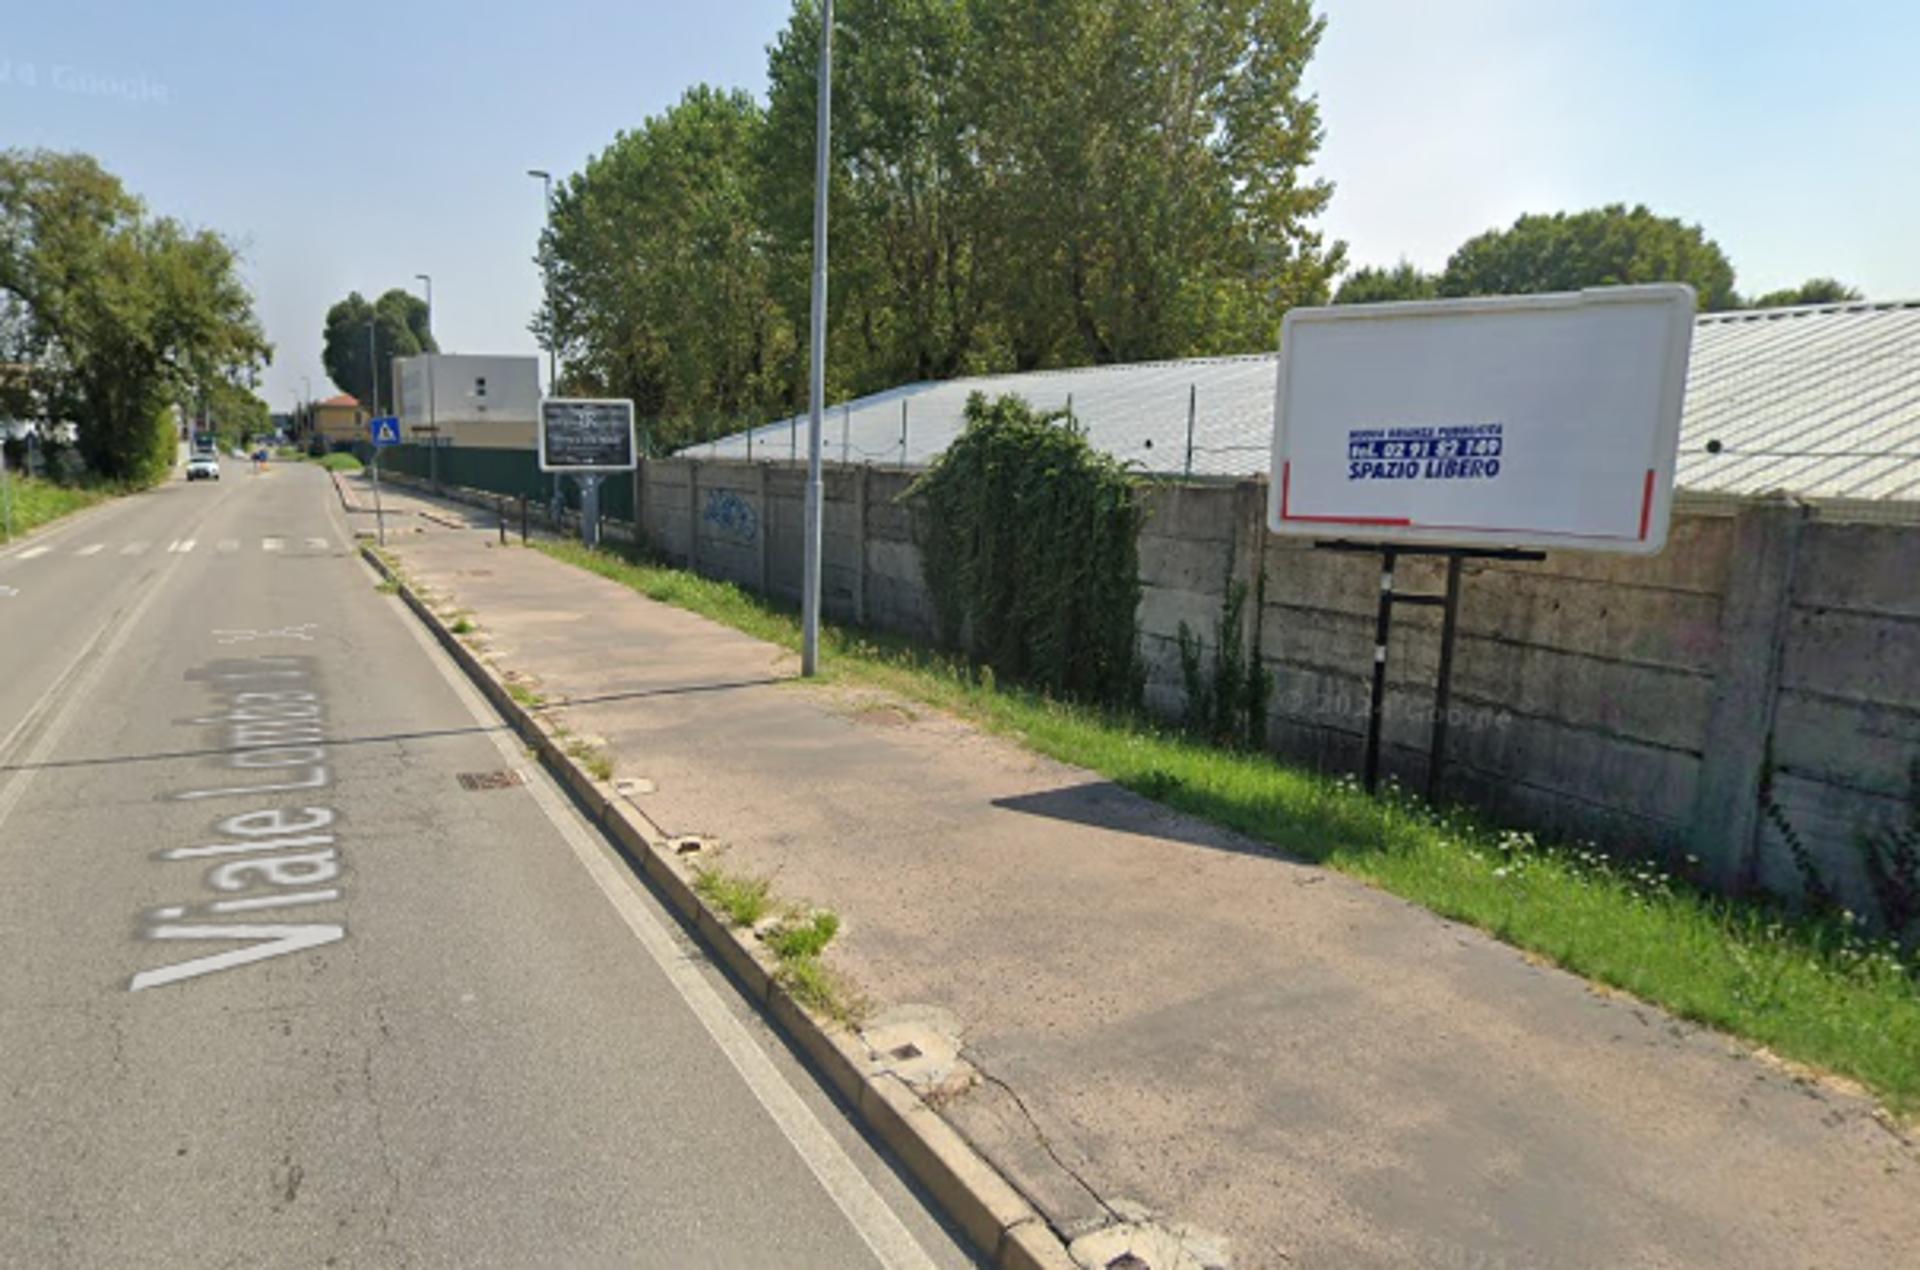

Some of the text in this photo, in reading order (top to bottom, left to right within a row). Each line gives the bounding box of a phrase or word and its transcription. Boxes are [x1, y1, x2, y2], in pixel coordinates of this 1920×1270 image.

[1384, 441, 1405, 458] 02
[1409, 441, 1430, 458] 91
[1465, 438, 1500, 456] 149
[1349, 458, 1500, 479] SPAZIO LIBERO
